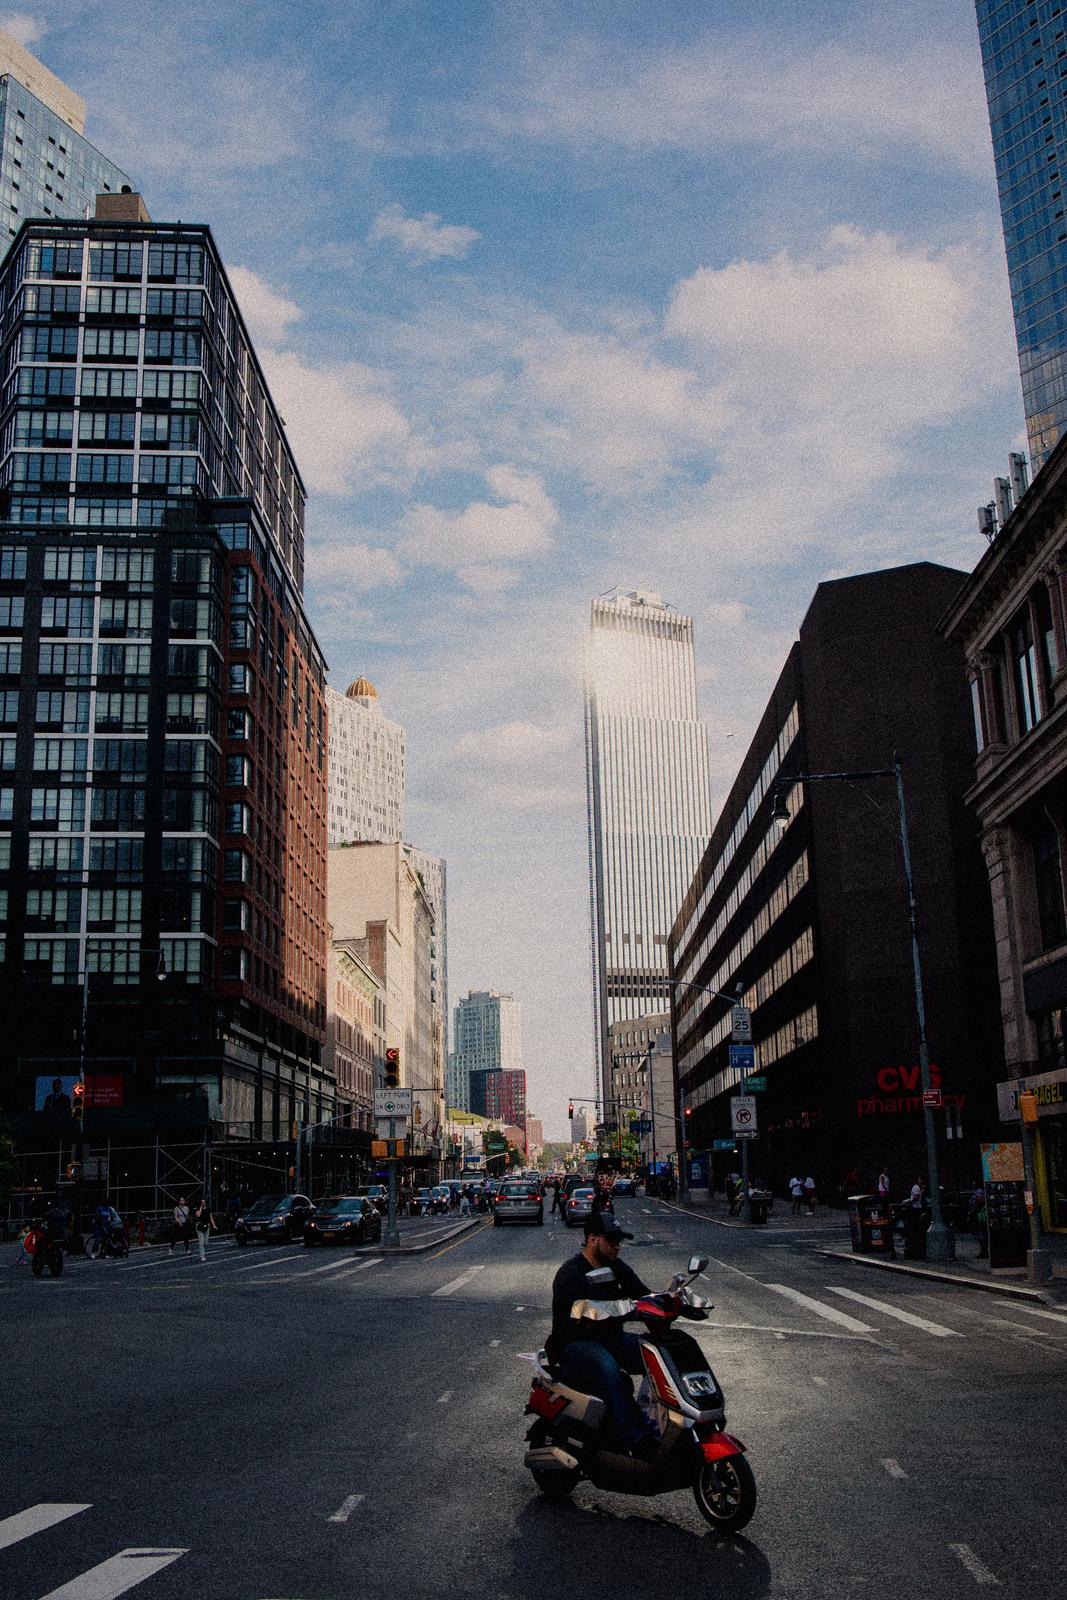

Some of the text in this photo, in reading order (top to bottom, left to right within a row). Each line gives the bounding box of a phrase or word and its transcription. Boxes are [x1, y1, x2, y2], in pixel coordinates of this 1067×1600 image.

[735, 1021, 749, 1030] 25
[876, 1064, 942, 1091] CVS
[856, 1091, 967, 1120] pharmcy
